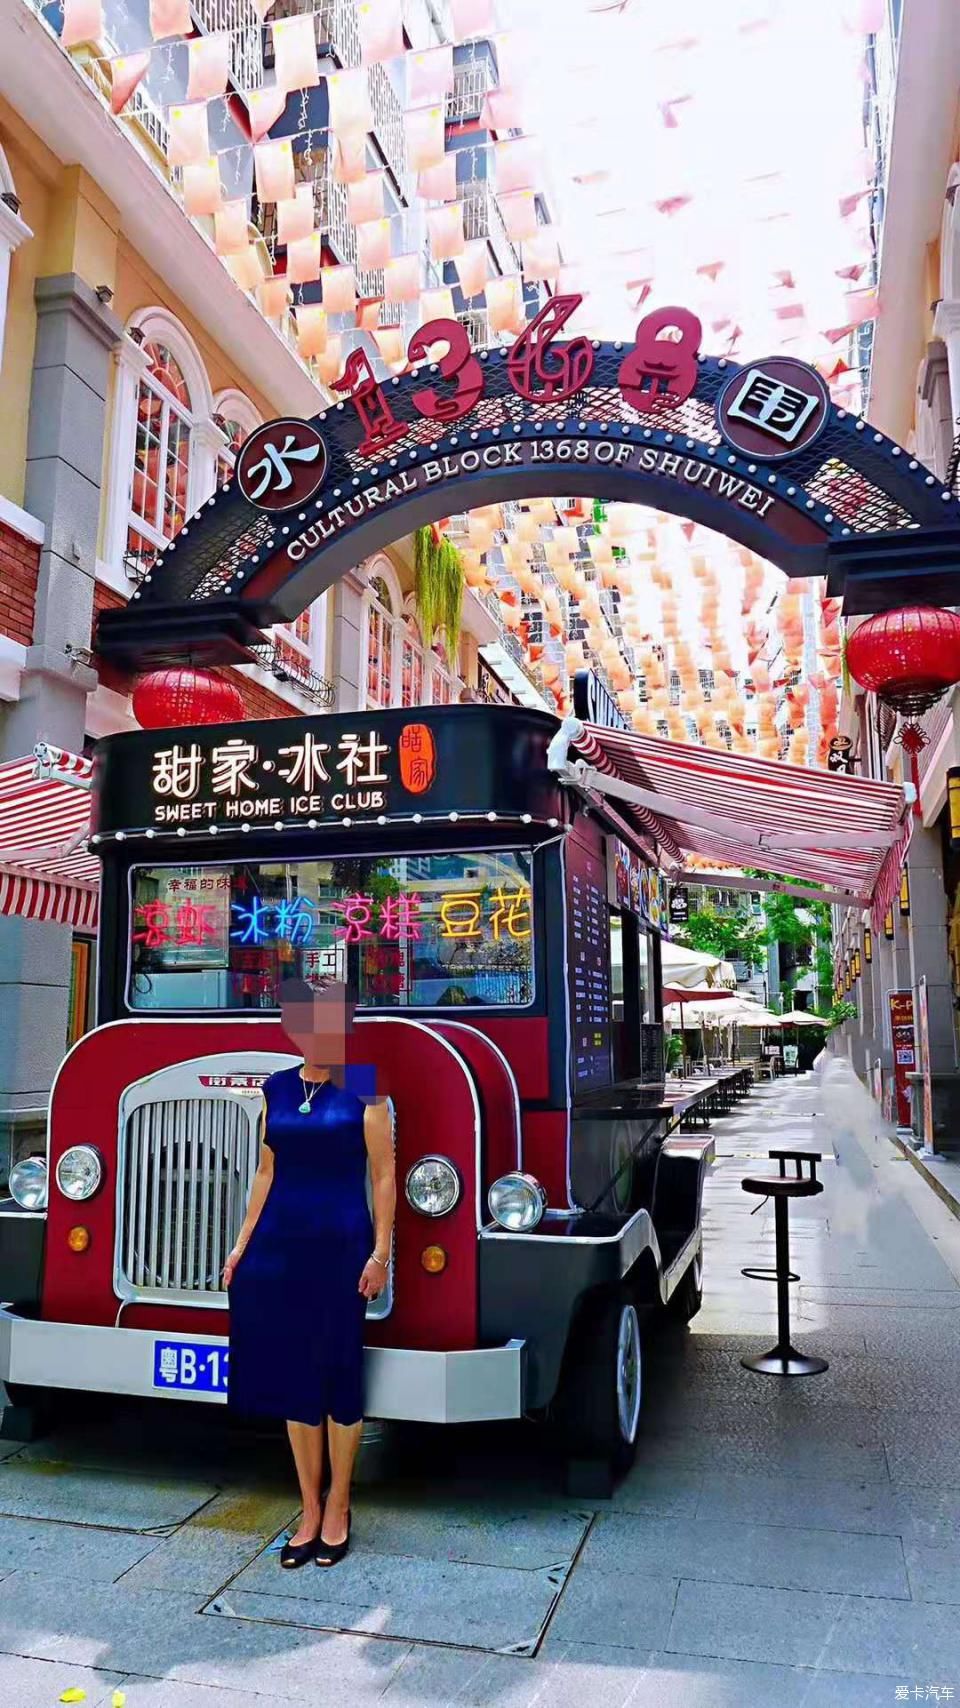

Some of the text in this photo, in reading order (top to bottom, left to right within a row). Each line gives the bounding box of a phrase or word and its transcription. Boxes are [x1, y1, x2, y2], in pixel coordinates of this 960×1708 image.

[247, 294, 820, 500] 水 1368 围
[286, 440, 777, 562] CULTURAL BLOCK 1368 OF SHUIWEI
[152, 731, 391, 799] 甜家·冰社
[155, 790, 384, 822] SWEET HOME ICE CLUB
[230, 895, 314, 944] 冰粉
[440, 887, 532, 941] 豆花
[159, 1346, 229, 1388] 粤B·1
